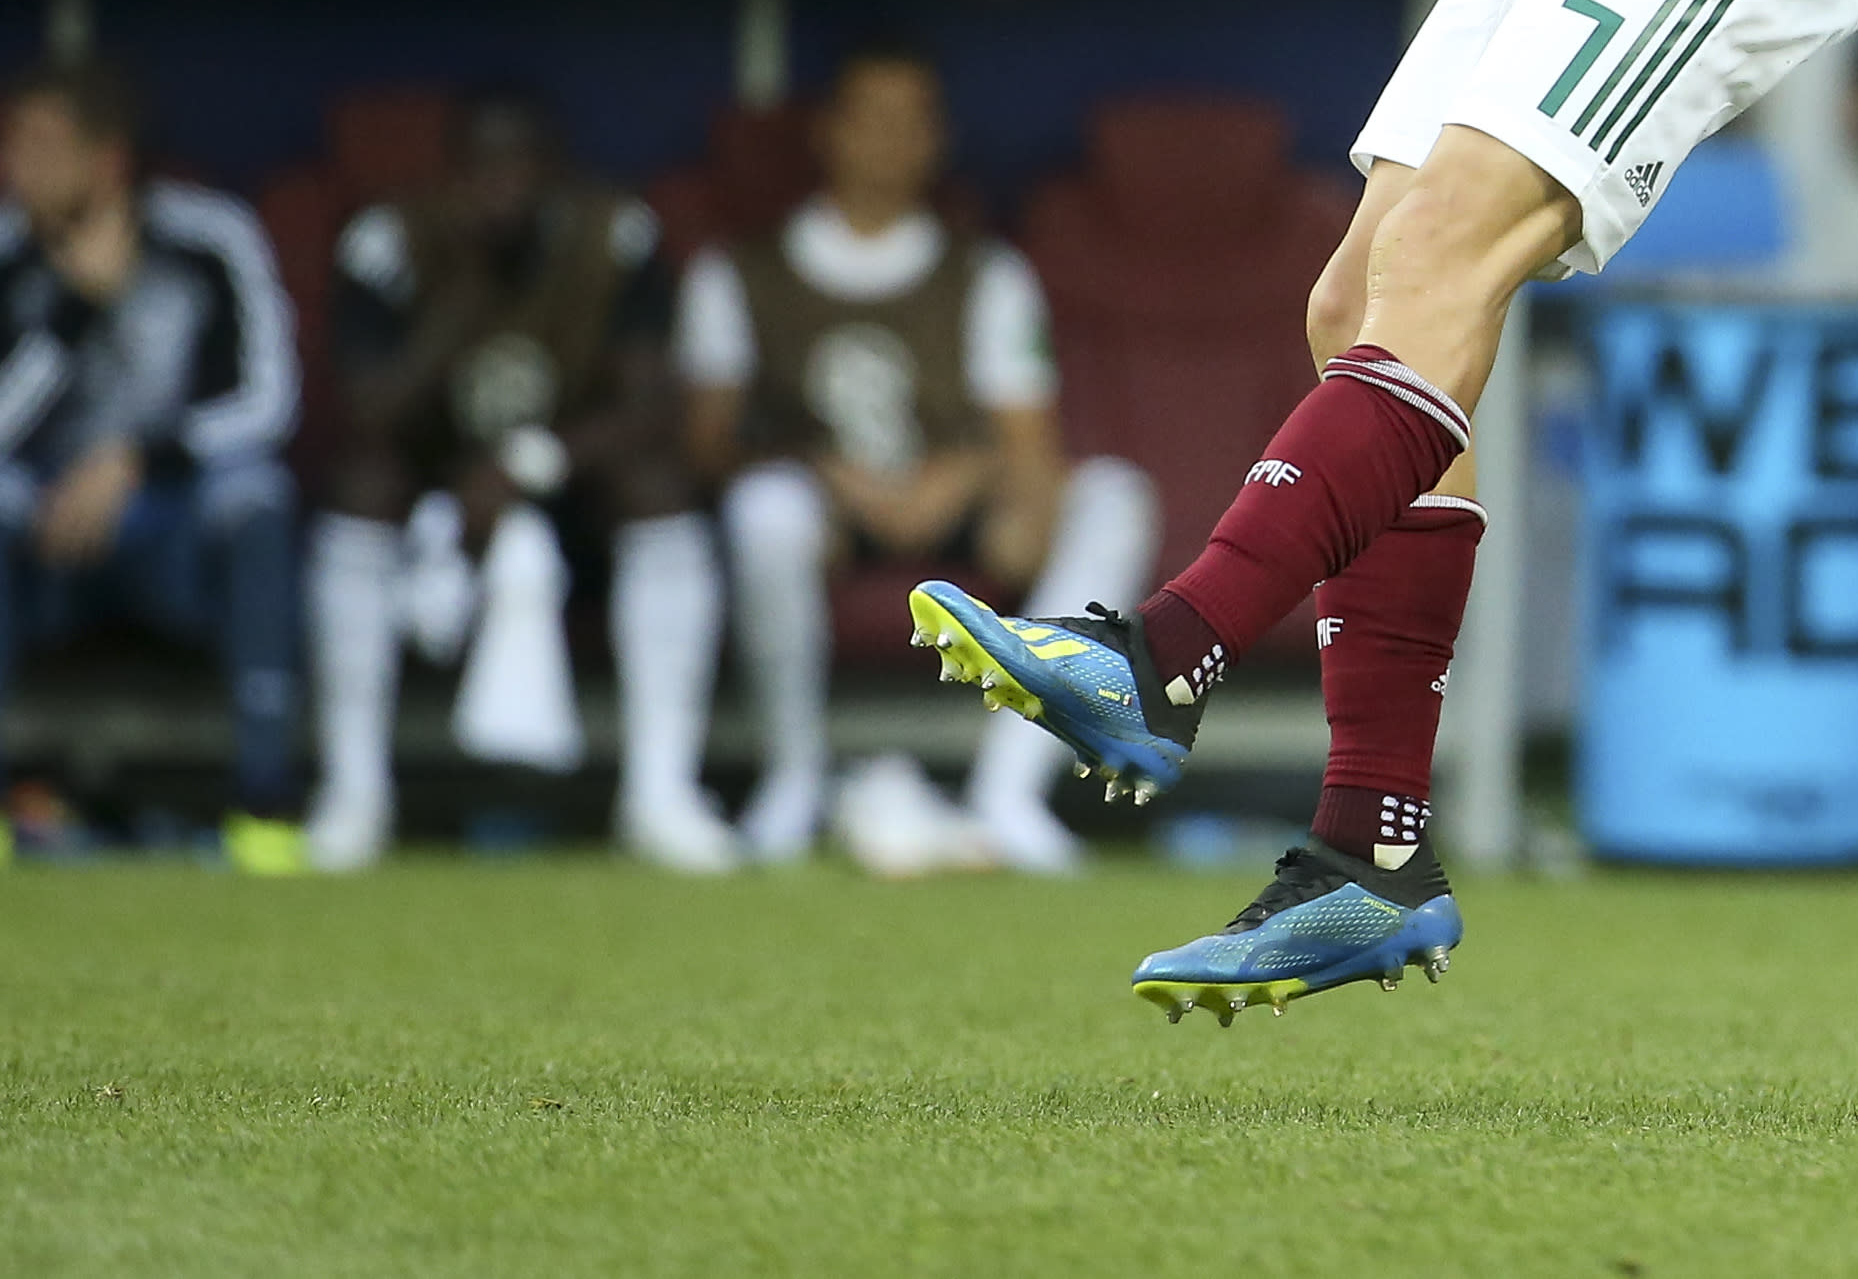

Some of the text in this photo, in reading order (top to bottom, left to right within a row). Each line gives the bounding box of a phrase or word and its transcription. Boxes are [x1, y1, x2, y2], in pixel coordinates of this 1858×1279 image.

[1624, 168, 1651, 208] adidas
[1243, 458, 1303, 488] FMF
[1316, 616, 1345, 651] MF
